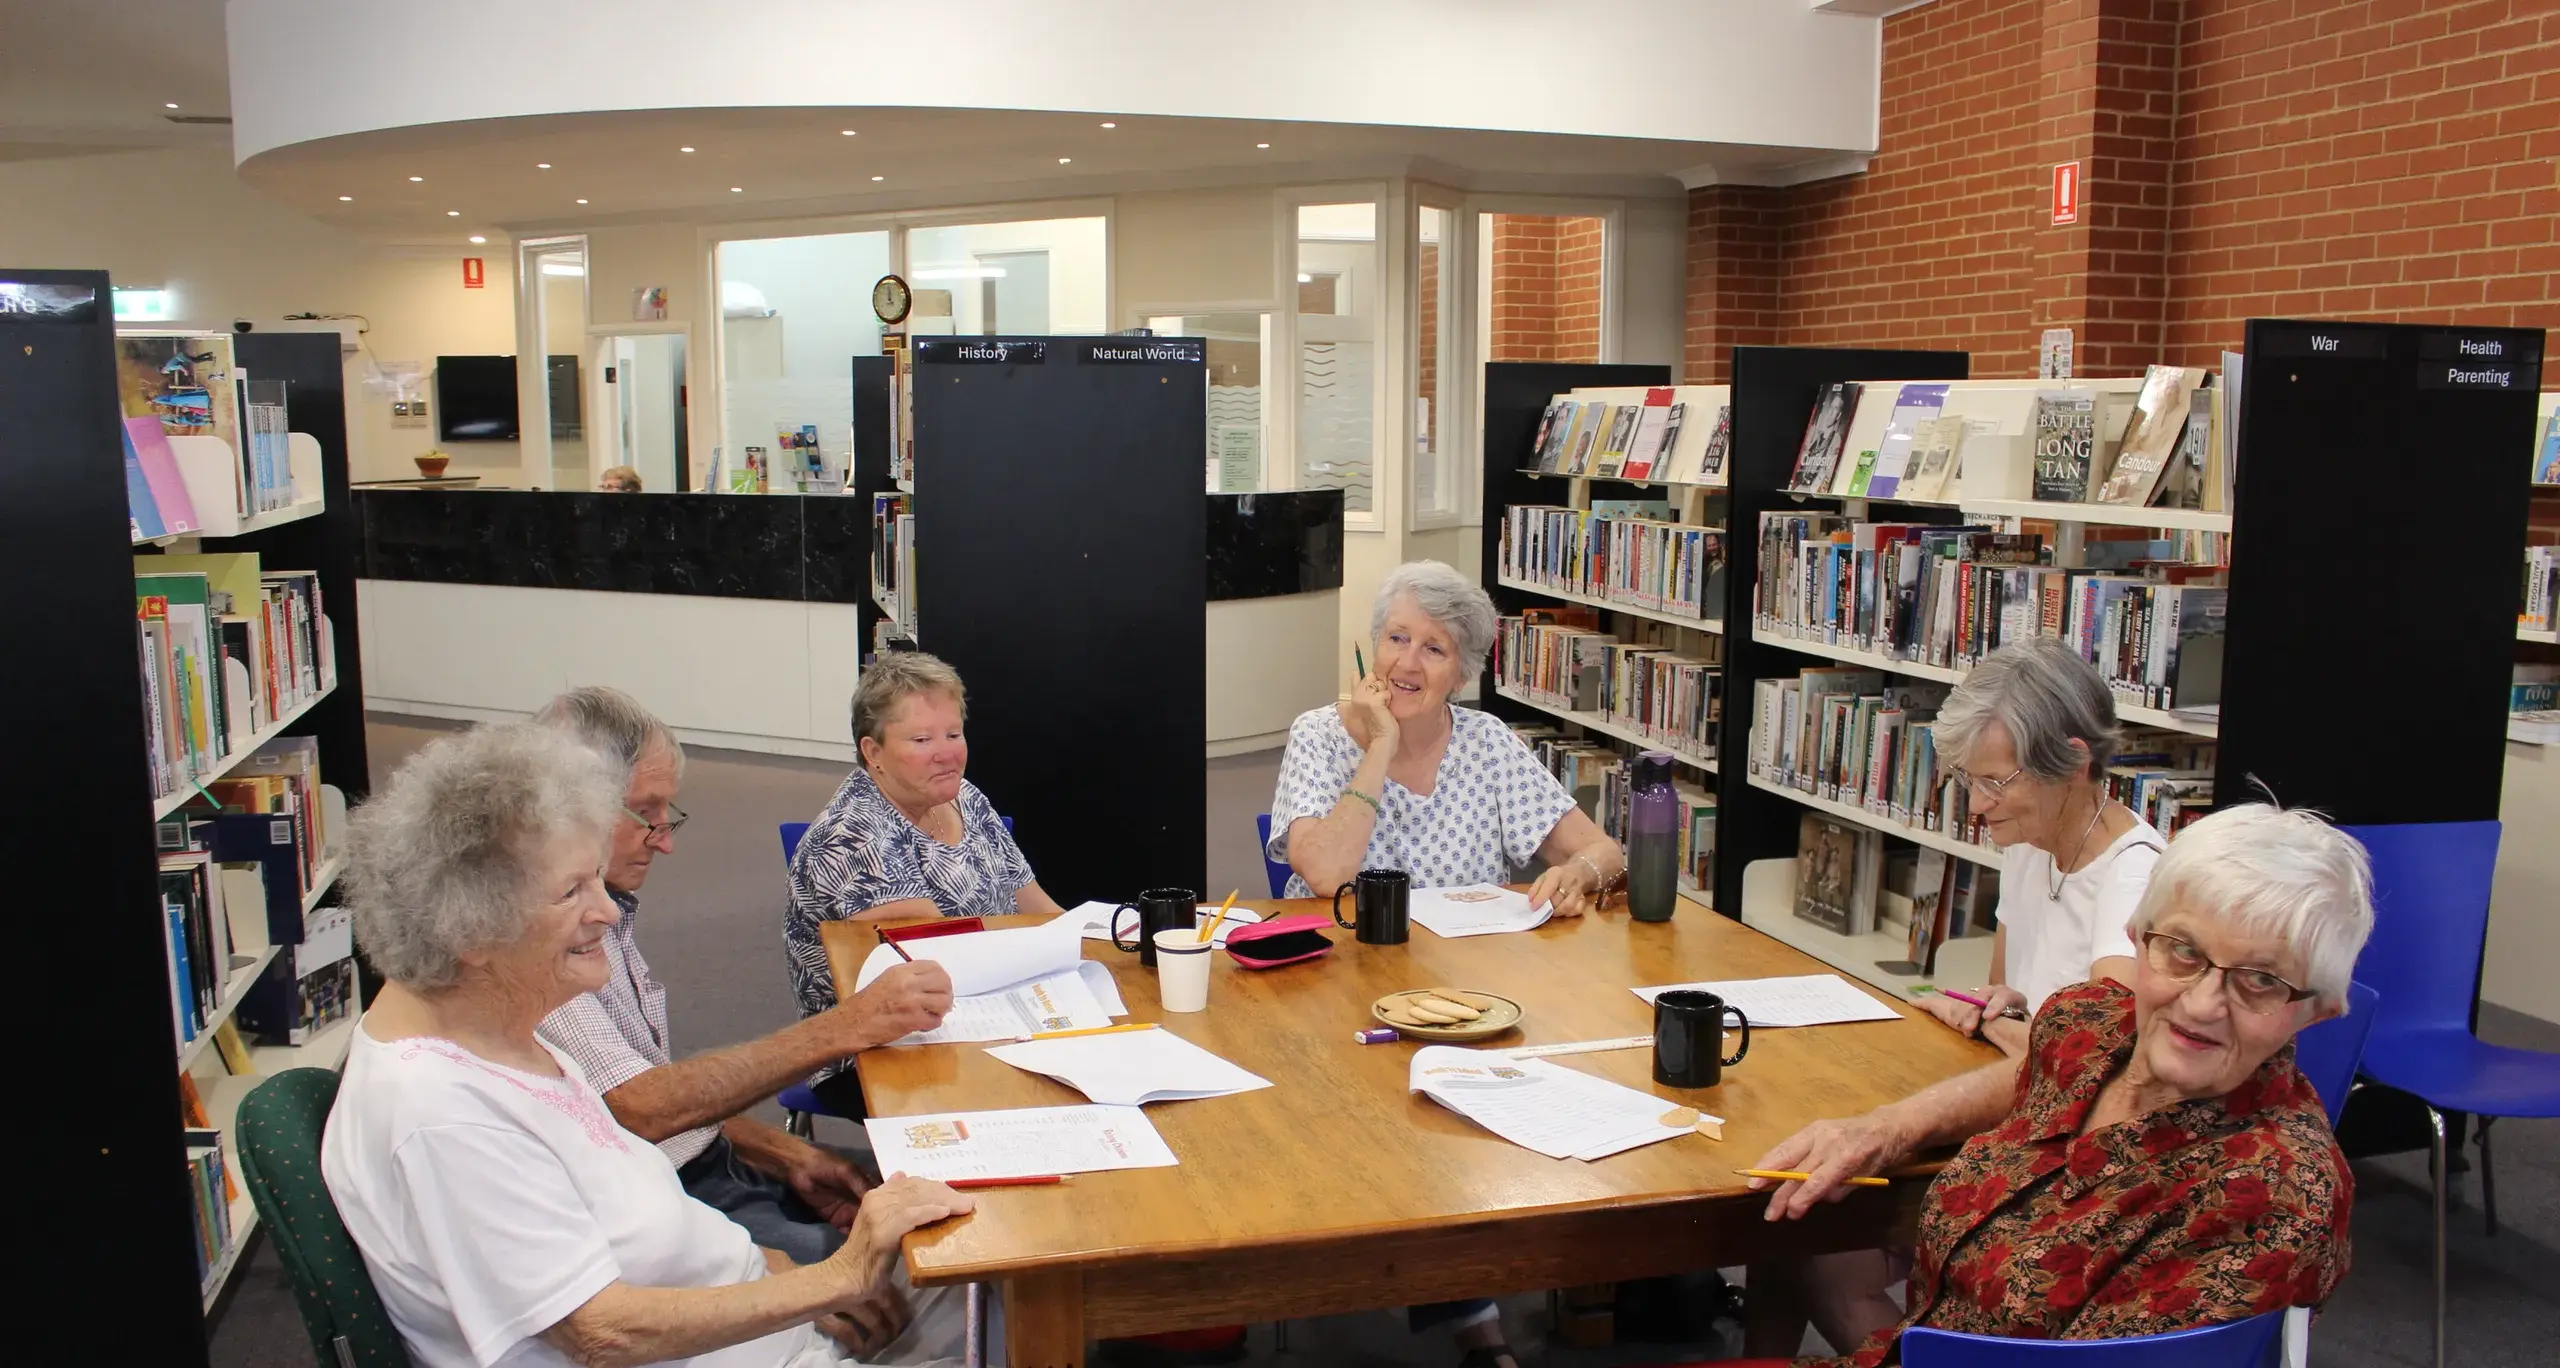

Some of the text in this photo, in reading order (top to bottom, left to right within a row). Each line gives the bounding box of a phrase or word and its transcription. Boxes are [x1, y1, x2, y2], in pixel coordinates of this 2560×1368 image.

[2311, 335, 2339, 351] War
[2459, 339, 2502, 356] Health
[958, 346, 1008, 361] History
[1093, 347, 1185, 360] Natural World
[2448, 368, 2510, 387] Parenting
[2040, 415, 2091, 428] BATTLE
[2037, 439, 2091, 458] LONG
[1801, 455, 1836, 470] Curiosity
[2042, 461, 2081, 479] TAN
[2118, 452, 2161, 473] Candour
[2043, 605, 2051, 628] HELL
[2051, 588, 2059, 628] DESCENT
